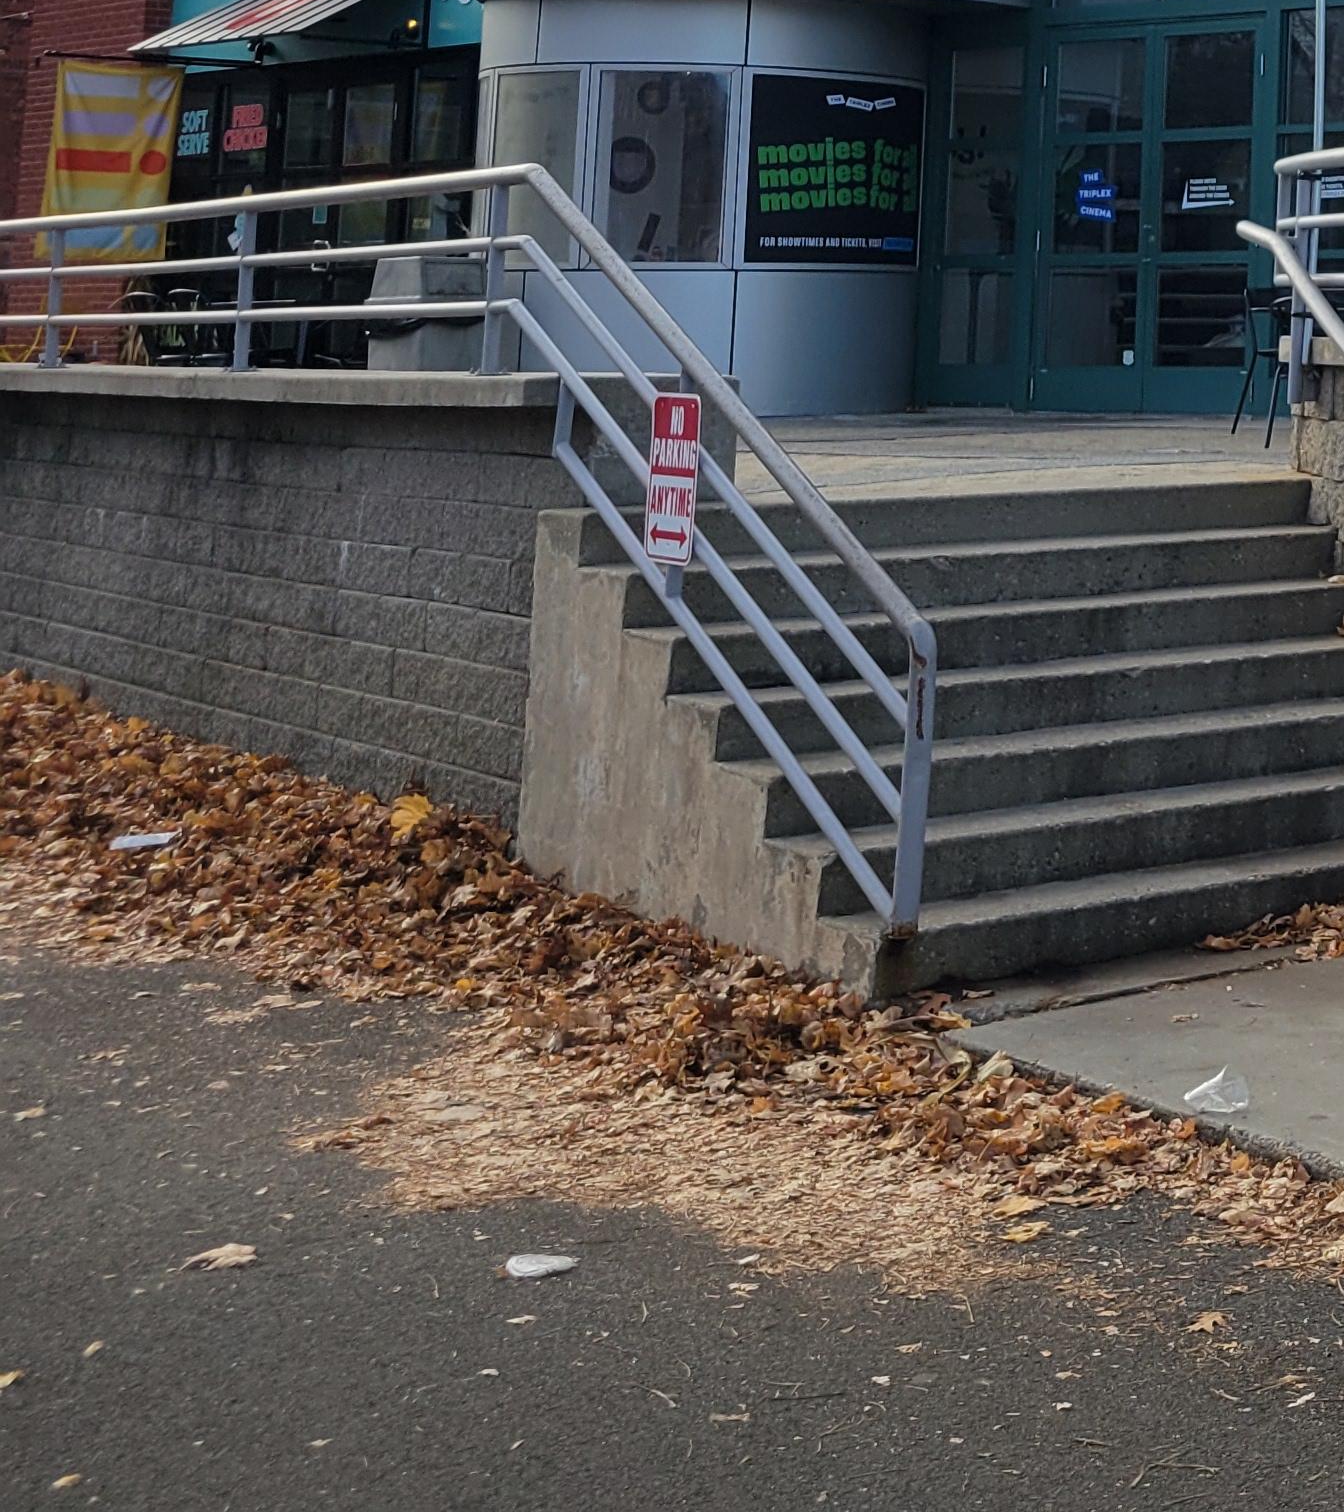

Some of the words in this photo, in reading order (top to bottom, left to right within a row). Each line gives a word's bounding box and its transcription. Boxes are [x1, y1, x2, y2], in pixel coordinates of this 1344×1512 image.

[181, 109, 208, 133] SOFT
[177, 132, 209, 156] SERVE
[757, 137, 866, 164] movies
[874, 139, 901, 165] for
[759, 161, 866, 188] movies
[872, 162, 899, 187] for
[1084, 172, 1099, 183] THE
[760, 184, 867, 212] movies
[870, 184, 898, 211] for
[1079, 189, 1112, 198] TRIPLEX
[1080, 206, 1112, 218] CINEMA
[760, 237, 775, 248] FOR
[777, 237, 823, 247] SHOWTIMES
[825, 237, 840, 247] AND
[670, 405, 685, 436] NO
[652, 438, 697, 470] PARKING
[650, 485, 691, 517] ANYTIME
